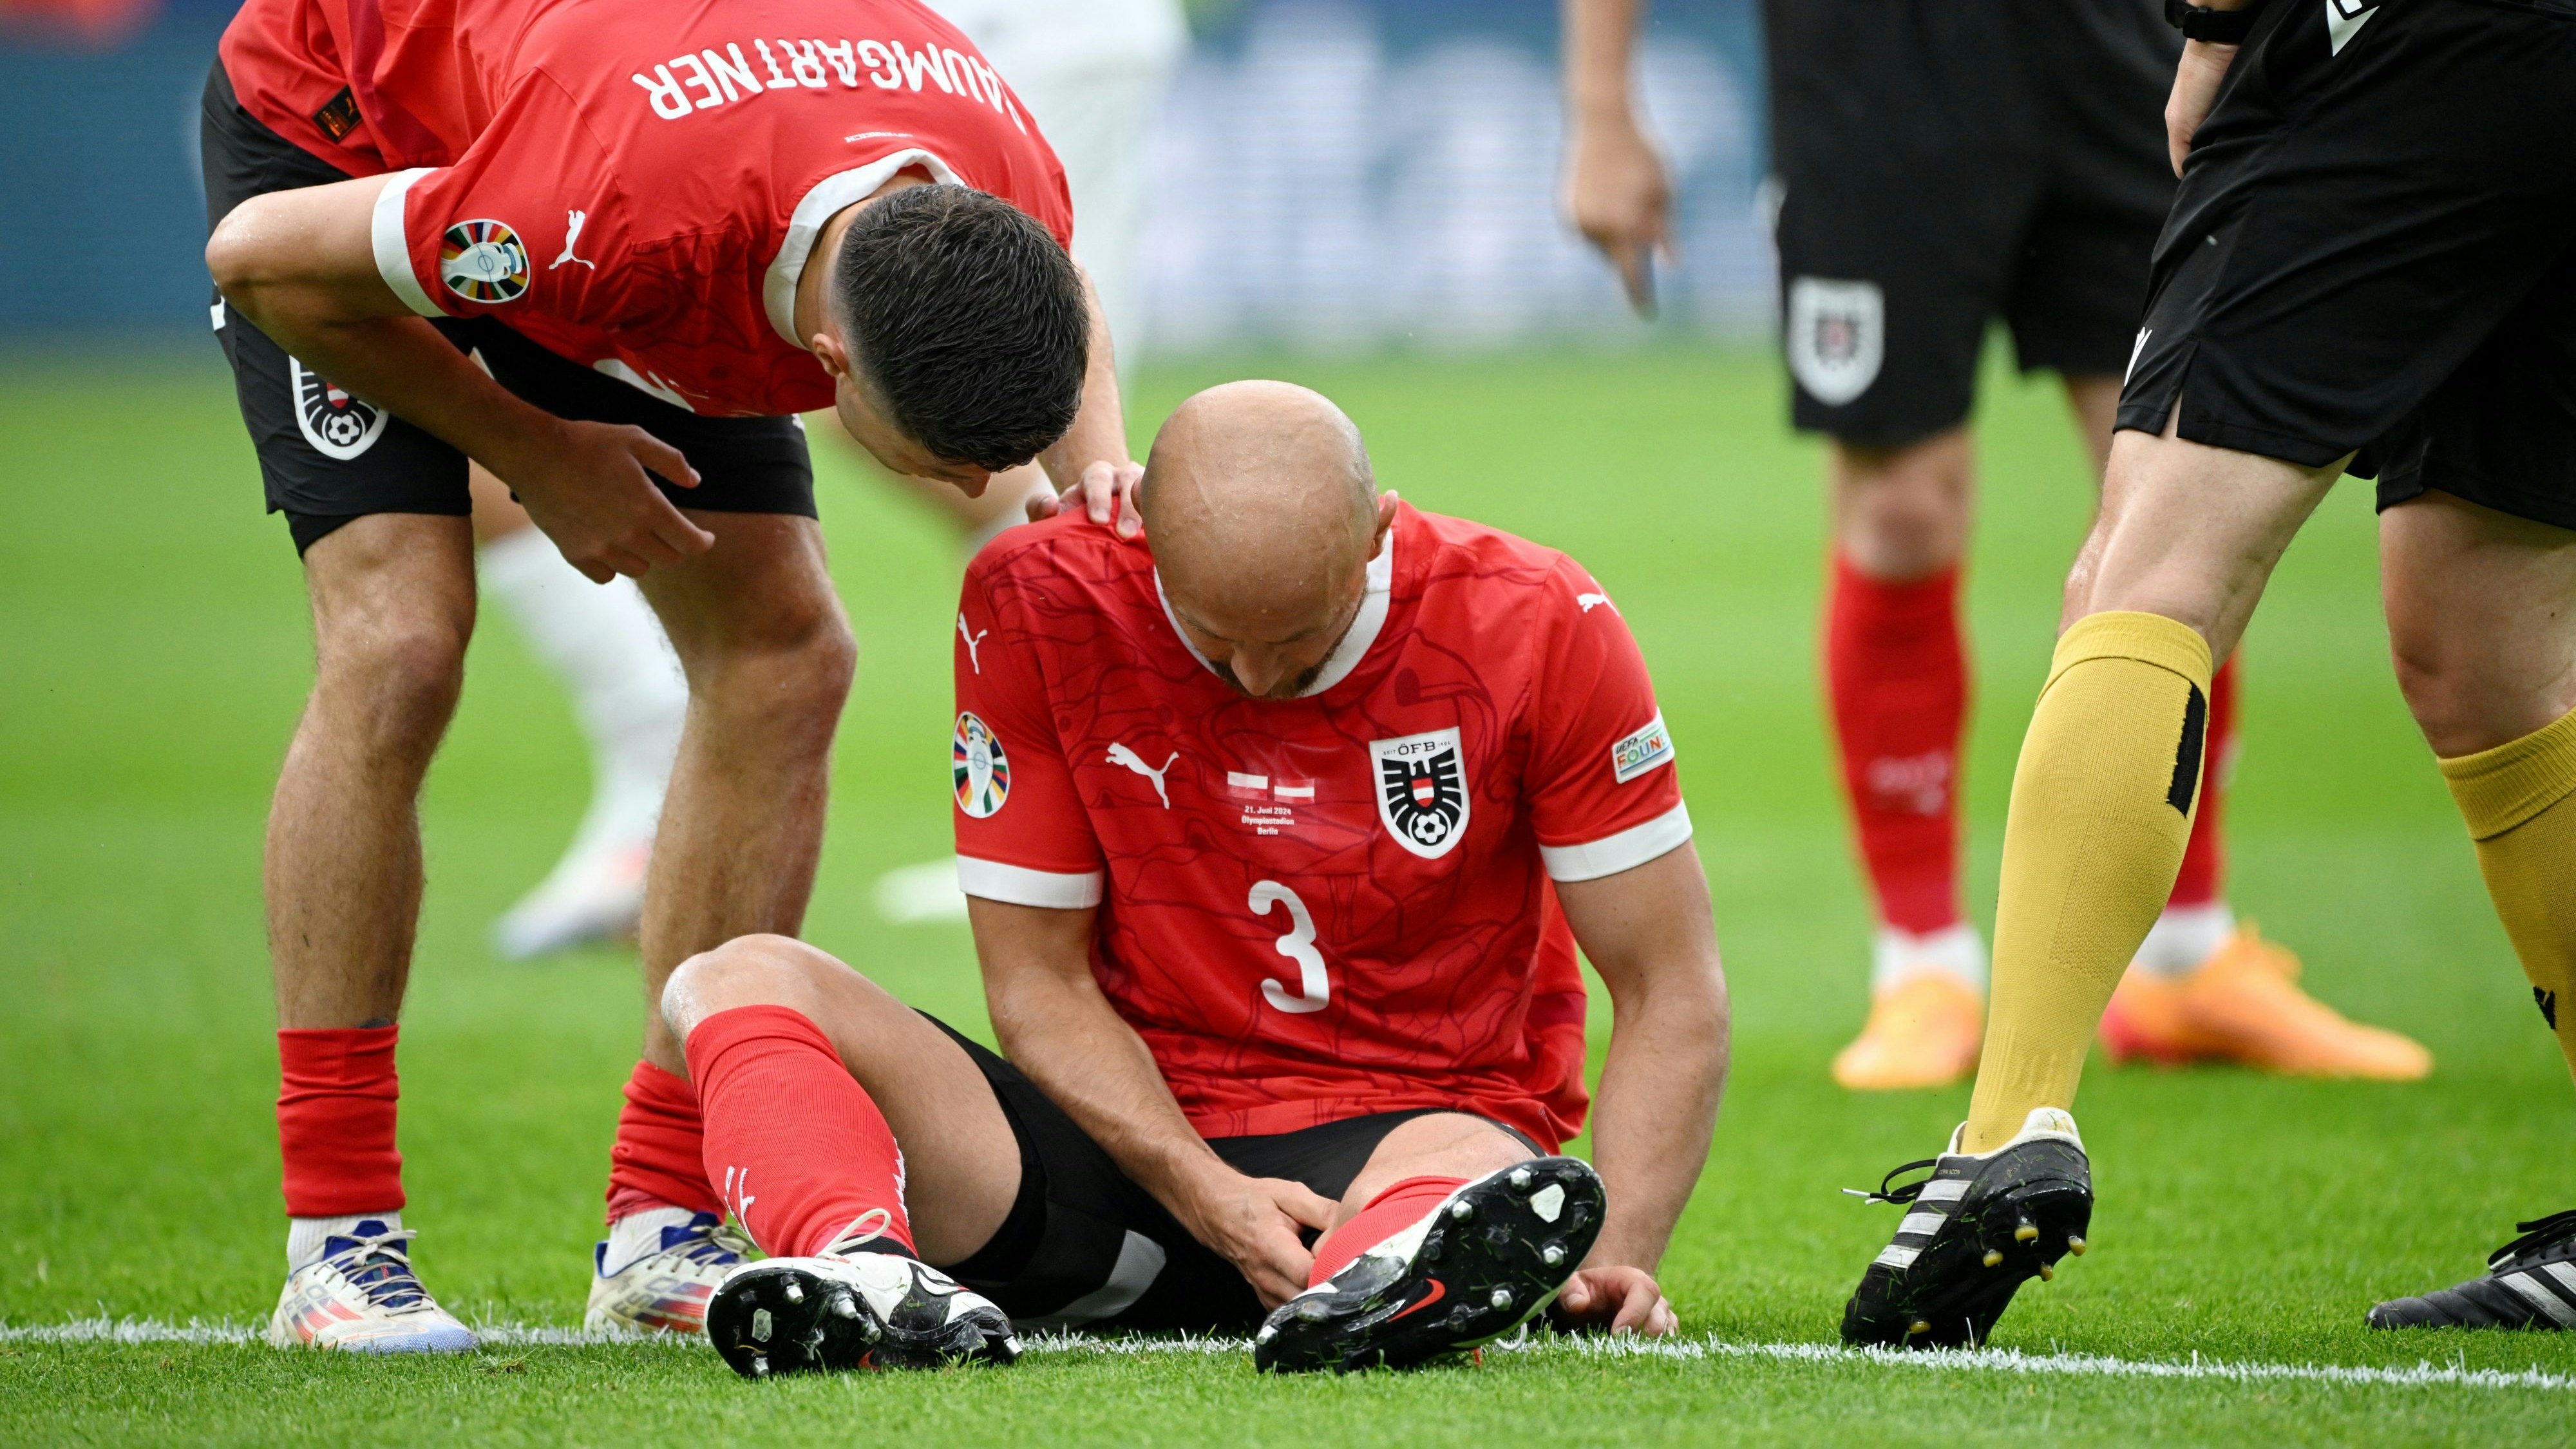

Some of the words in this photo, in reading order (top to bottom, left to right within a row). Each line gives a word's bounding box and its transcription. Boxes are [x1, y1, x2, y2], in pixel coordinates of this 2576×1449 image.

[1398, 741, 1435, 755] ÖFB
[1616, 737, 1639, 755] UEFA
[1616, 735, 1665, 767] FOUN
[1245, 806, 1256, 814] 21.
[1257, 806, 1273, 815] Juni
[1274, 807, 1292, 815] 2024
[1241, 815, 1294, 826] Olympiastadion
[1257, 827, 1278, 835] Berlin
[1248, 880, 1330, 1014] 3
